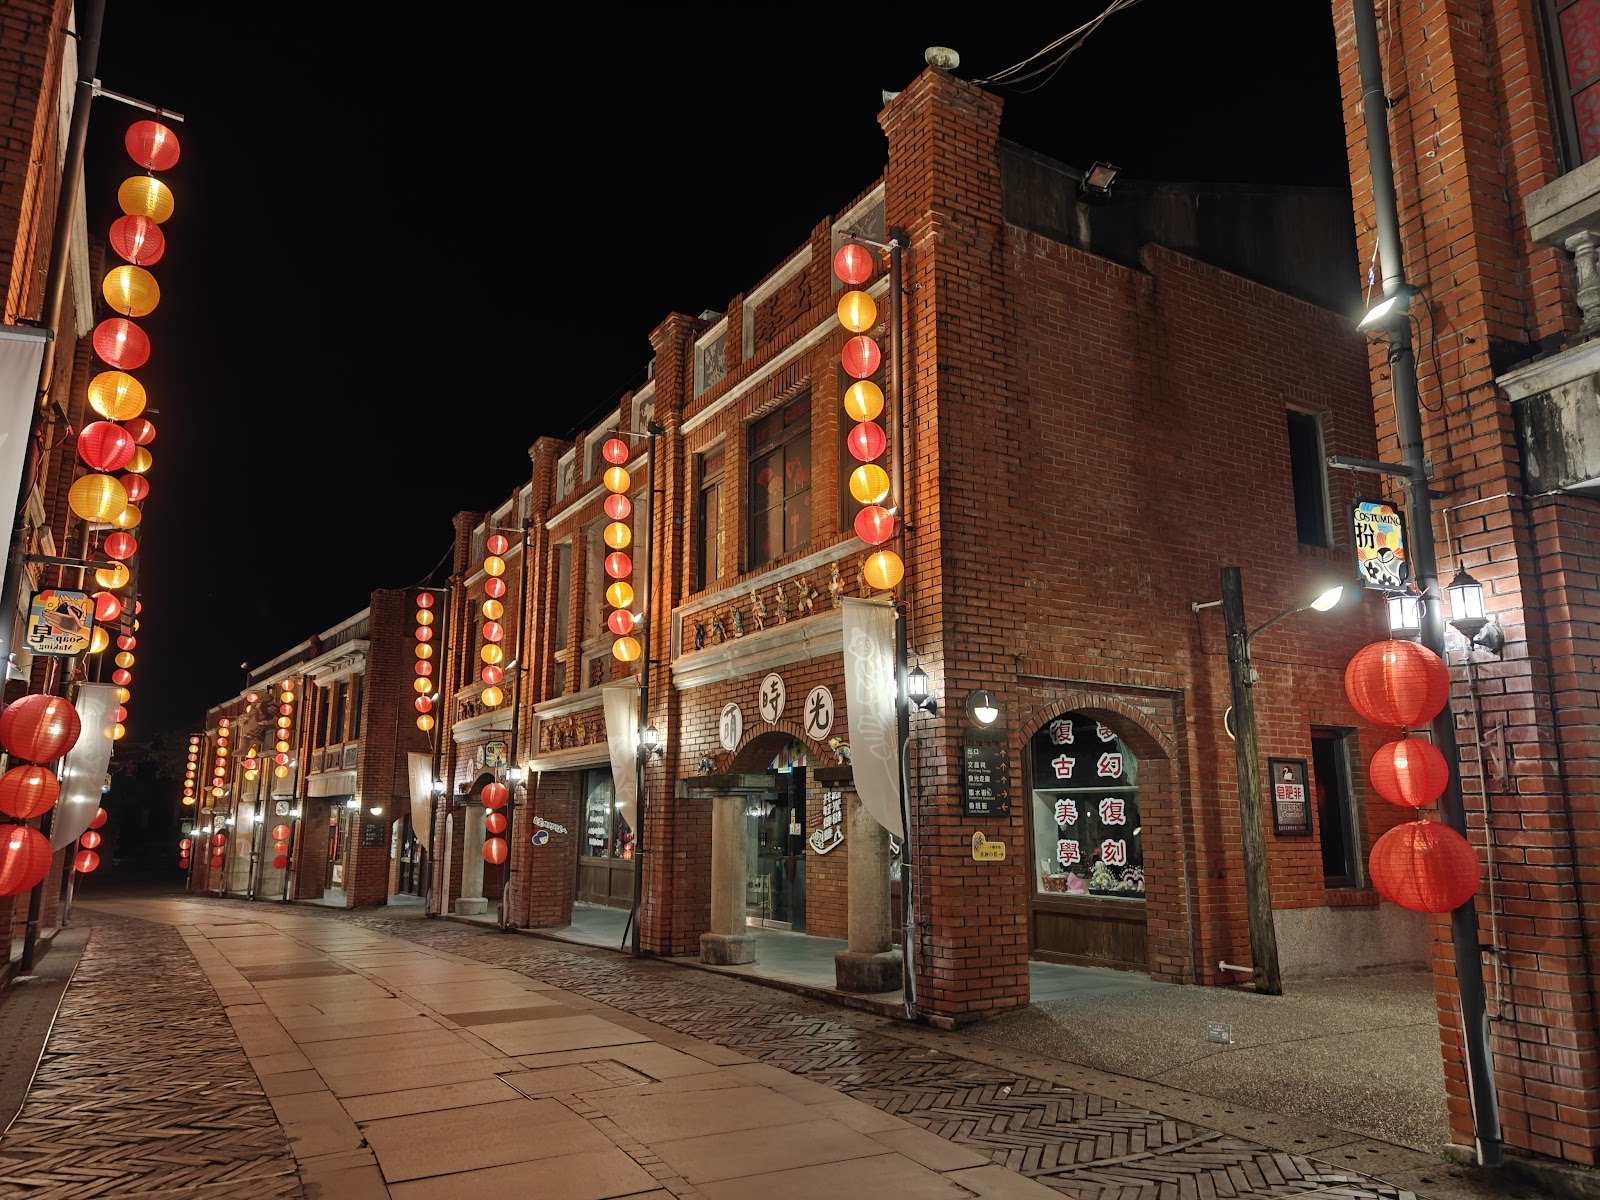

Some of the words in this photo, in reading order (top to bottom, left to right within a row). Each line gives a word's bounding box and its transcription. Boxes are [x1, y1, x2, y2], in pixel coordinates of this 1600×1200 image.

[1354, 522, 1375, 549] 扮
[1051, 720, 1079, 865] 復古美學
